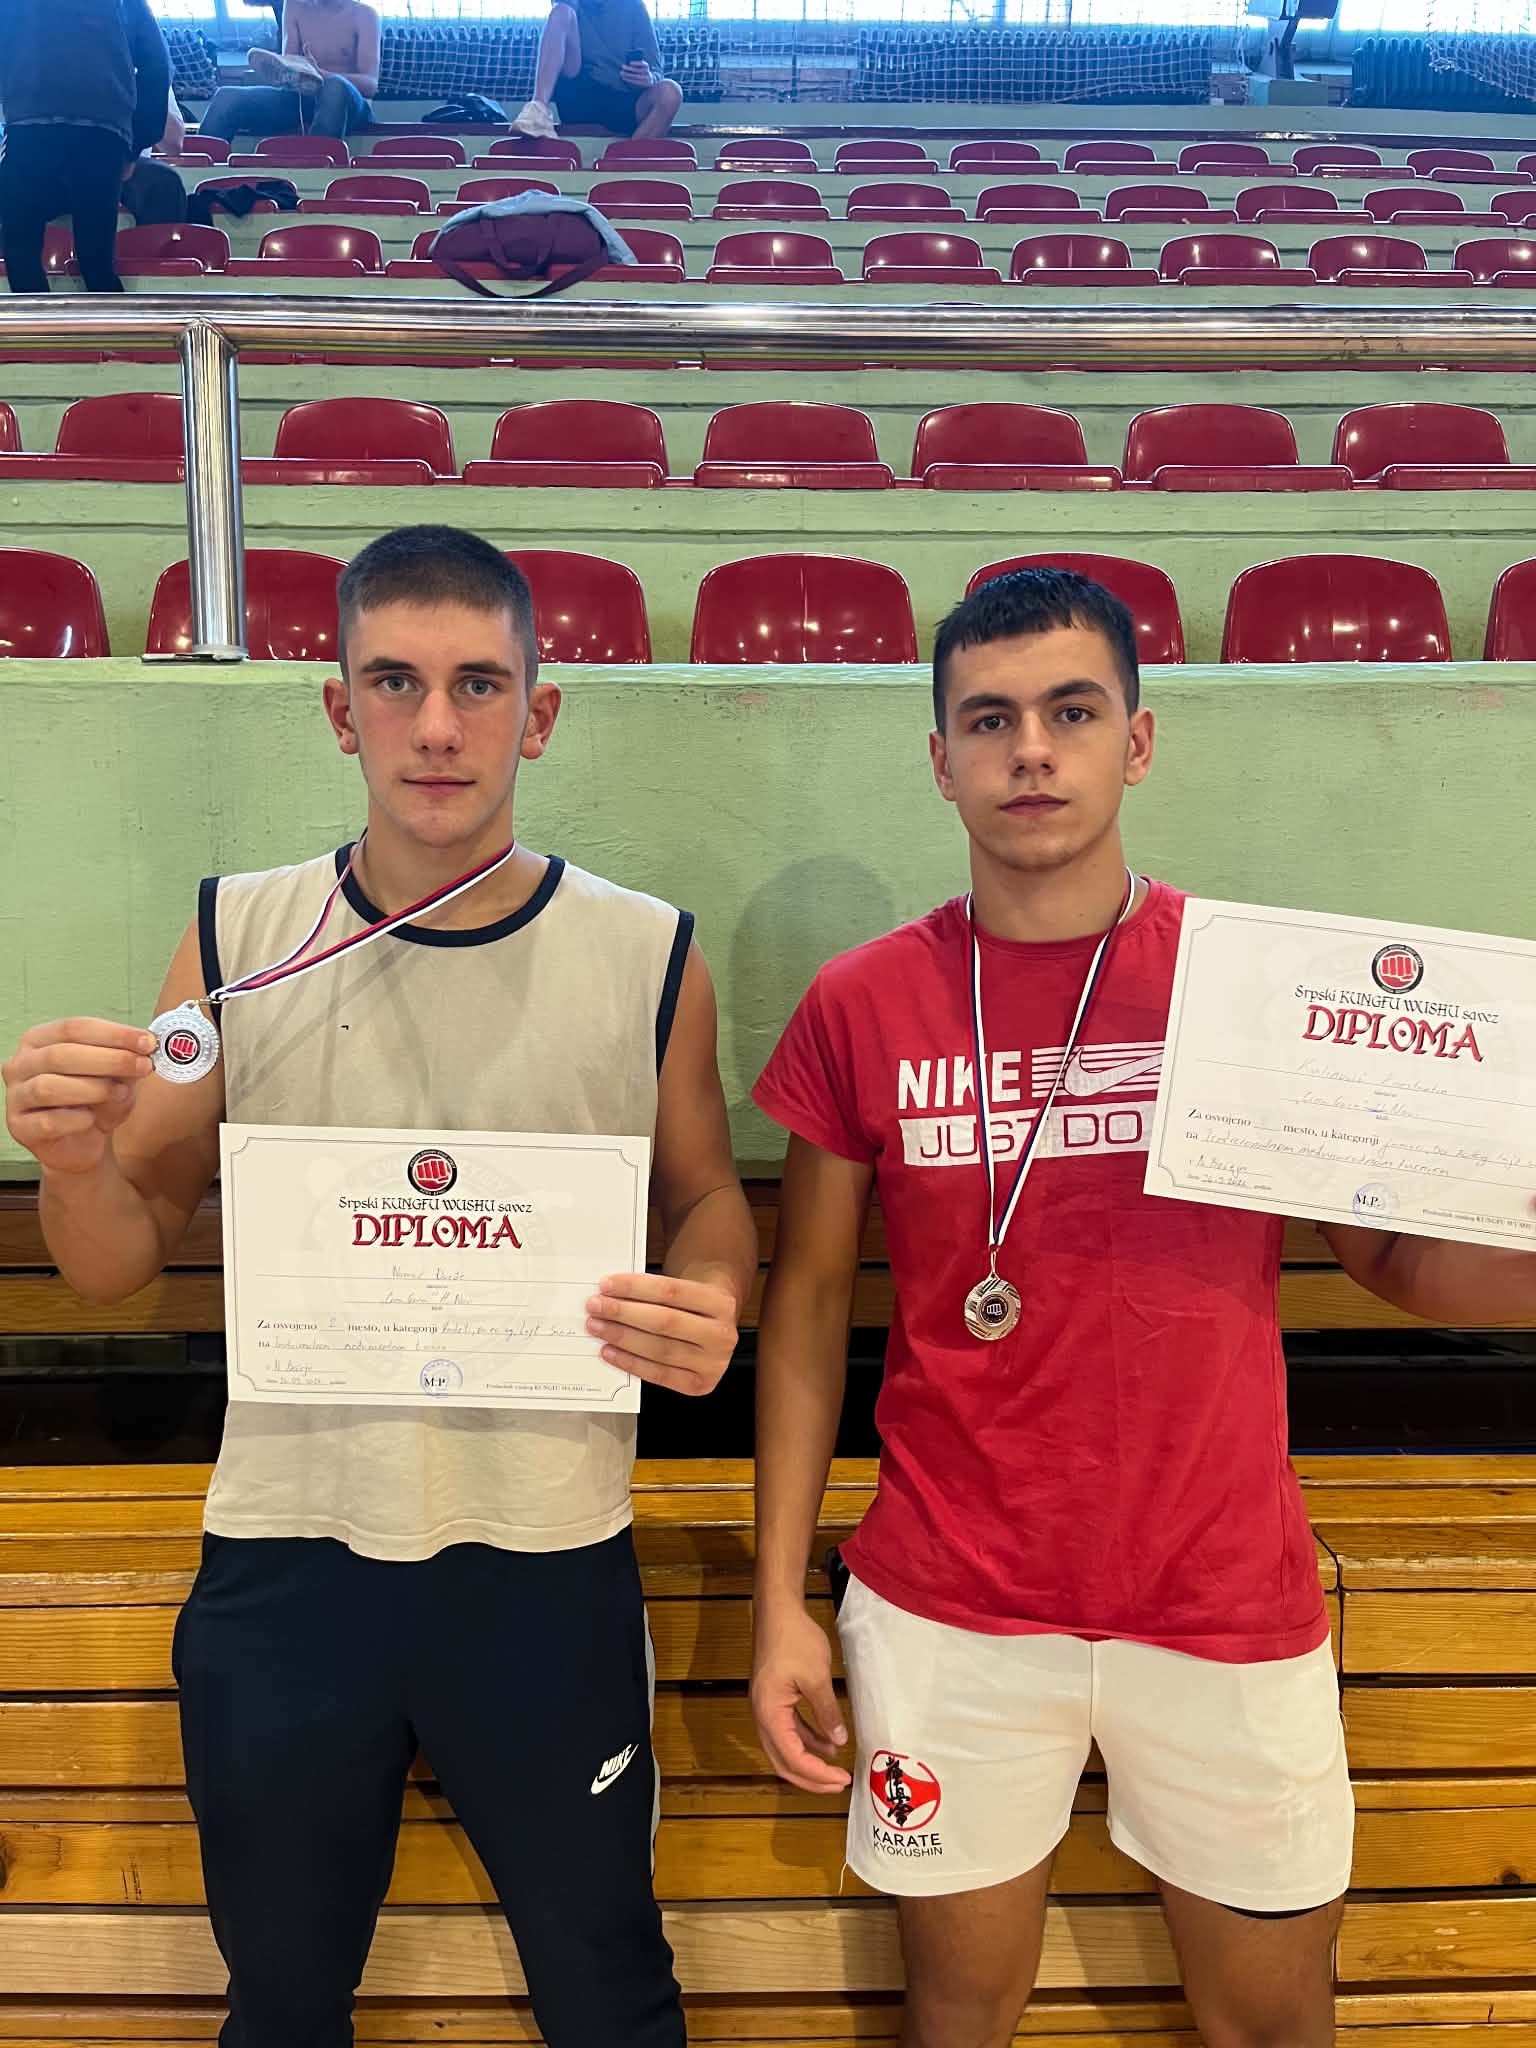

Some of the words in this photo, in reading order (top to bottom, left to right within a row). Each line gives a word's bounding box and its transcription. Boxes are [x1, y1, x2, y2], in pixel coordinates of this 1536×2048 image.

[1295, 984, 1336, 1003] Srpski
[1339, 991, 1400, 1010] KUNGFU
[1404, 998, 1460, 1018] WUSHU
[1302, 1004, 1484, 1062] DIPLOMA
[898, 1051, 1022, 1110] NIKE
[1204, 1112, 1251, 1127] osvojeno
[1063, 1110, 1143, 1148] DO
[1186, 1131, 1198, 1140] na
[1321, 1130, 1328, 1138] u
[1331, 1129, 1379, 1147] kategoriji
[338, 1196, 378, 1211] Srpski
[381, 1198, 439, 1211] KUNGFU
[442, 1199, 495, 1212] WUSHU
[498, 1203, 533, 1213] savez
[352, 1213, 522, 1249] DIPLOMA
[257, 1320, 270, 1329] Za
[273, 1322, 318, 1332] osvojeno
[348, 1323, 381, 1332] mesto,
[393, 1322, 438, 1334] kategoriji
[258, 1340, 270, 1348] na
[599, 1744, 631, 1780] NIKE
[873, 1825, 942, 1847] KARATE
[873, 1841, 943, 1858] KYOKUSHIN
